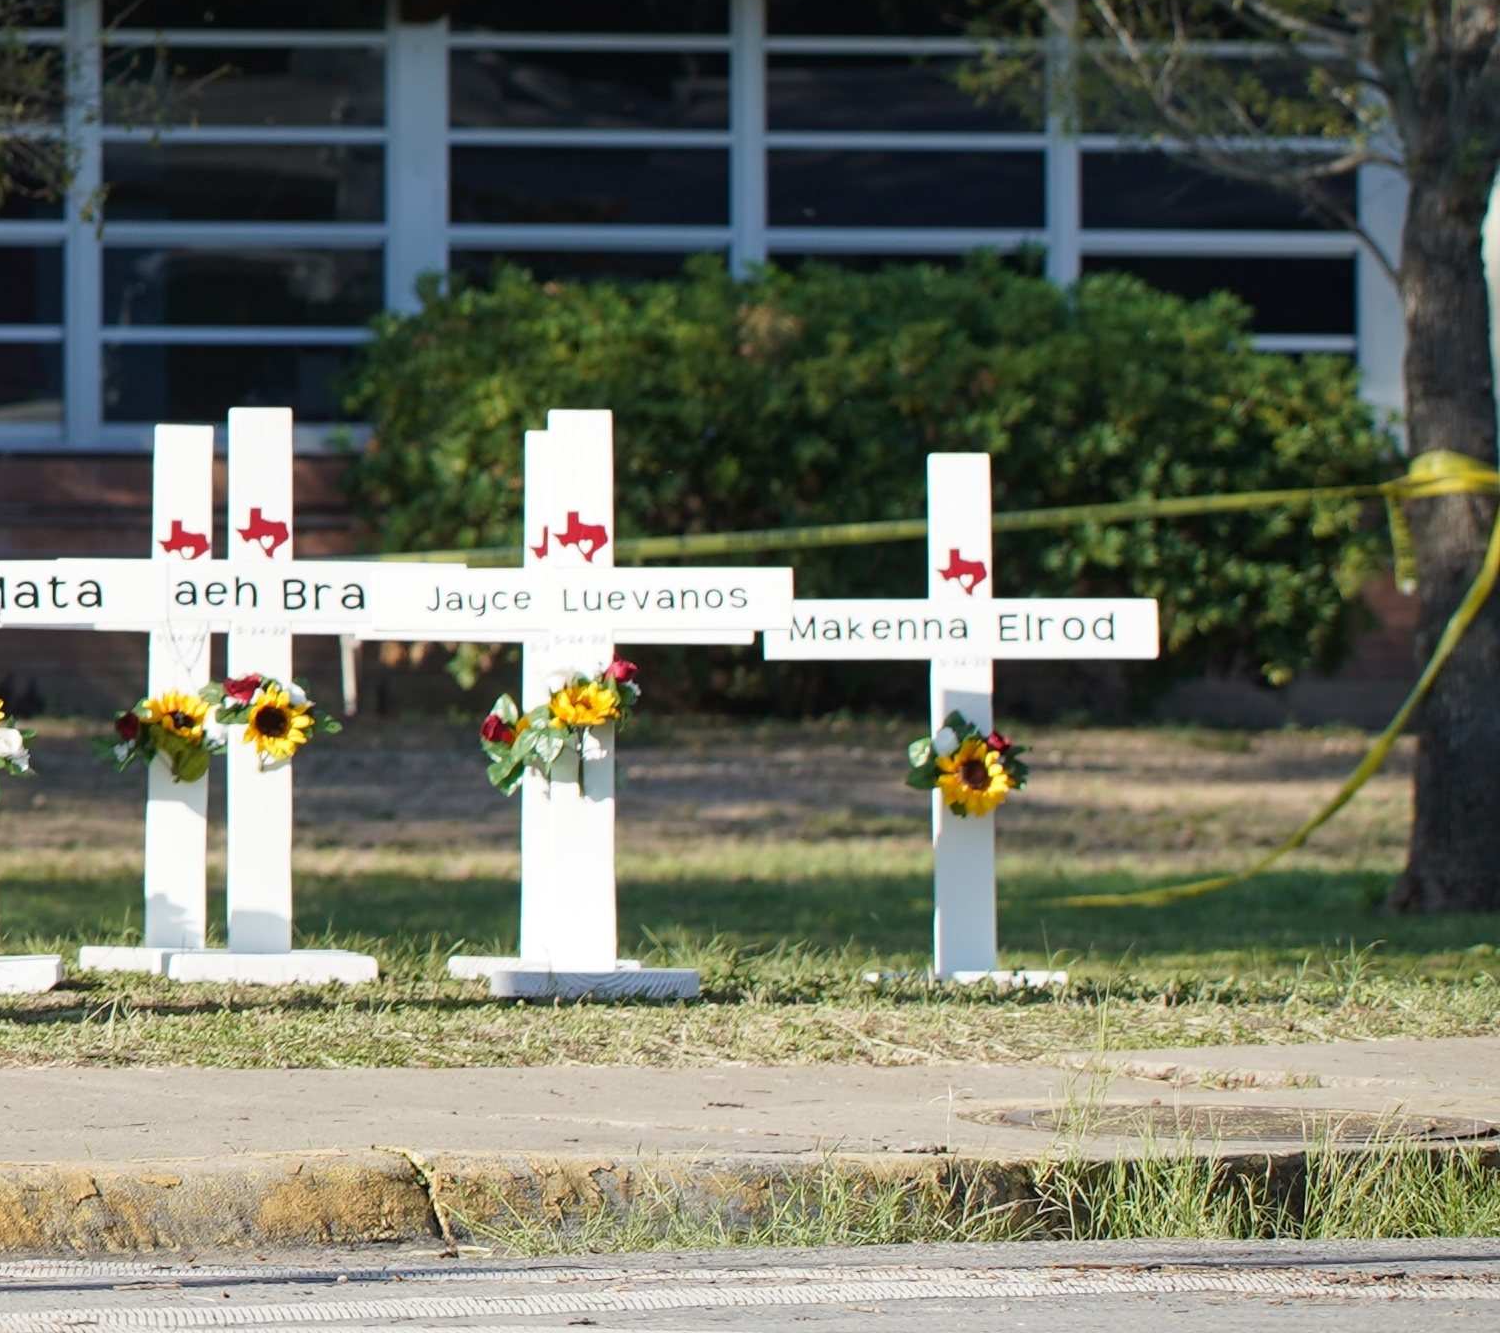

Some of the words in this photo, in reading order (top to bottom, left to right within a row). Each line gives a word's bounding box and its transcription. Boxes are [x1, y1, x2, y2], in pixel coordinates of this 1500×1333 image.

[175, 577, 257, 607] aeh
[283, 579, 364, 610] Bra
[427, 587, 531, 616] Jayce
[564, 588, 747, 611] Luevanos
[790, 617, 967, 640] Makenna
[999, 613, 1114, 641] Elrod
